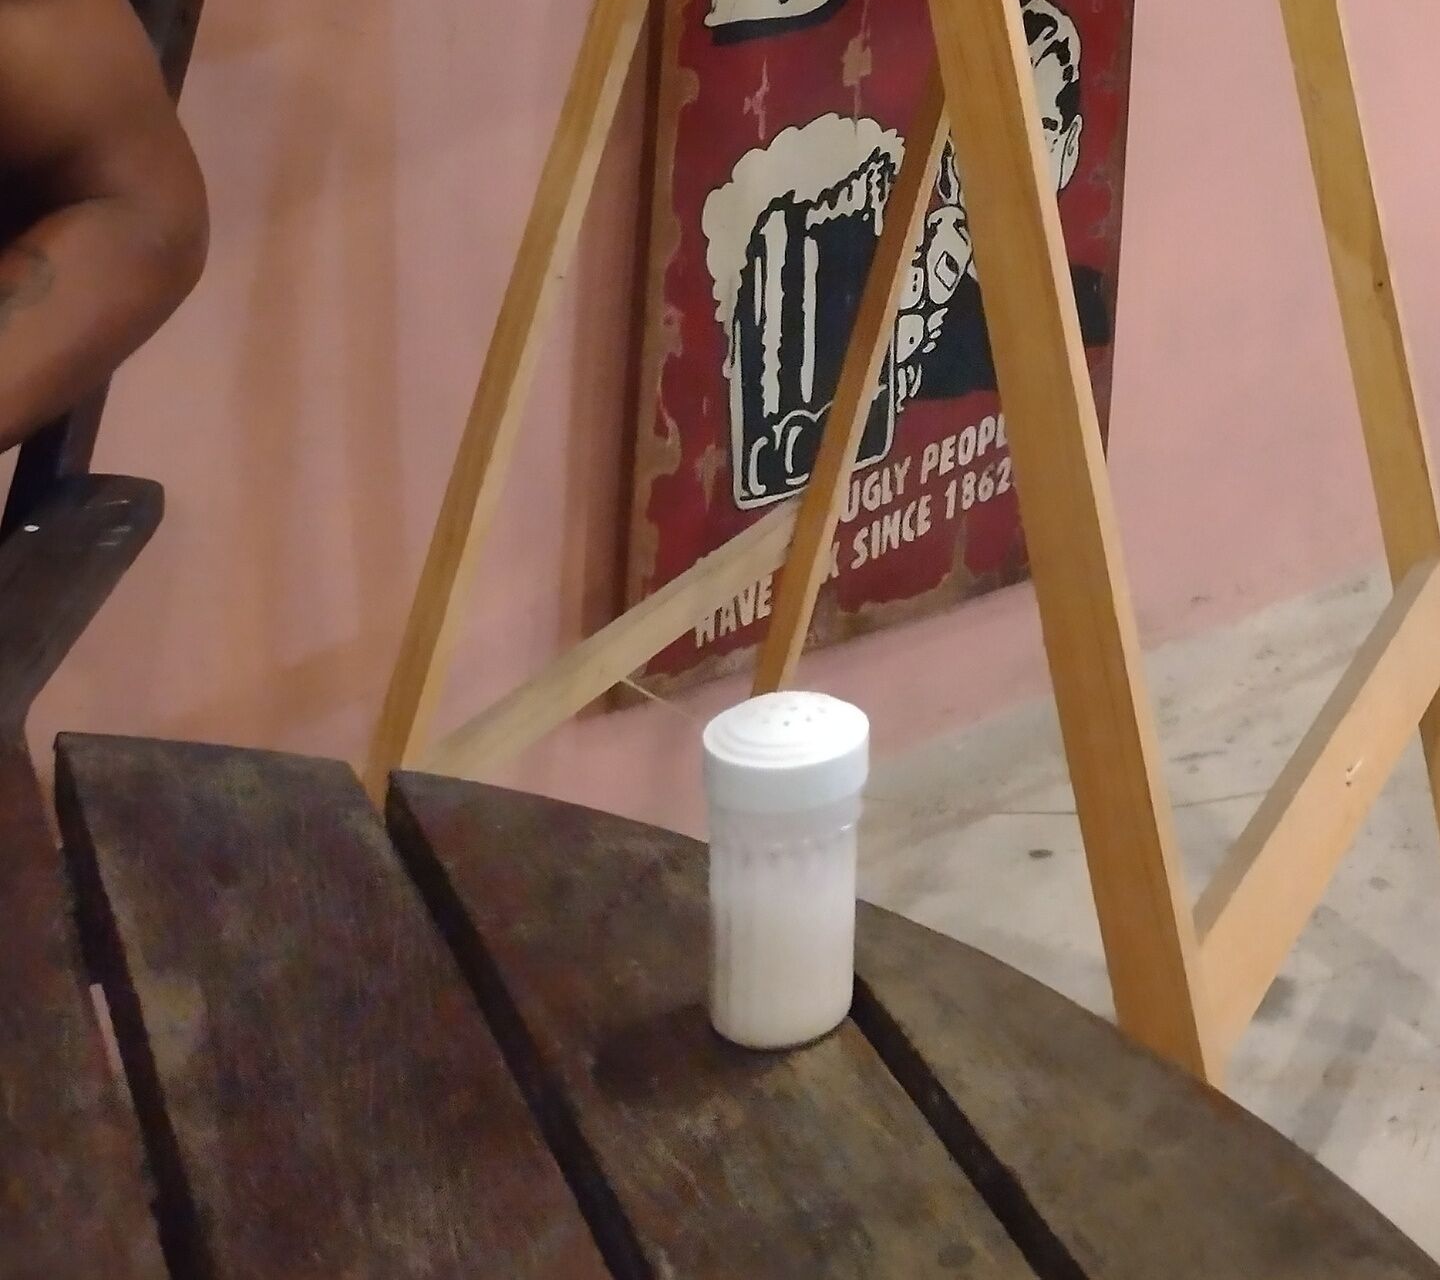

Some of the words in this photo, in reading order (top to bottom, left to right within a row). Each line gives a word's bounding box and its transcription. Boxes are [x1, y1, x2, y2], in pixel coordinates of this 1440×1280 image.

[839, 455, 912, 523] UGLY
[920, 413, 1009, 483] PEOPL
[851, 495, 932, 569] SINCE
[945, 457, 1012, 519] 1862
